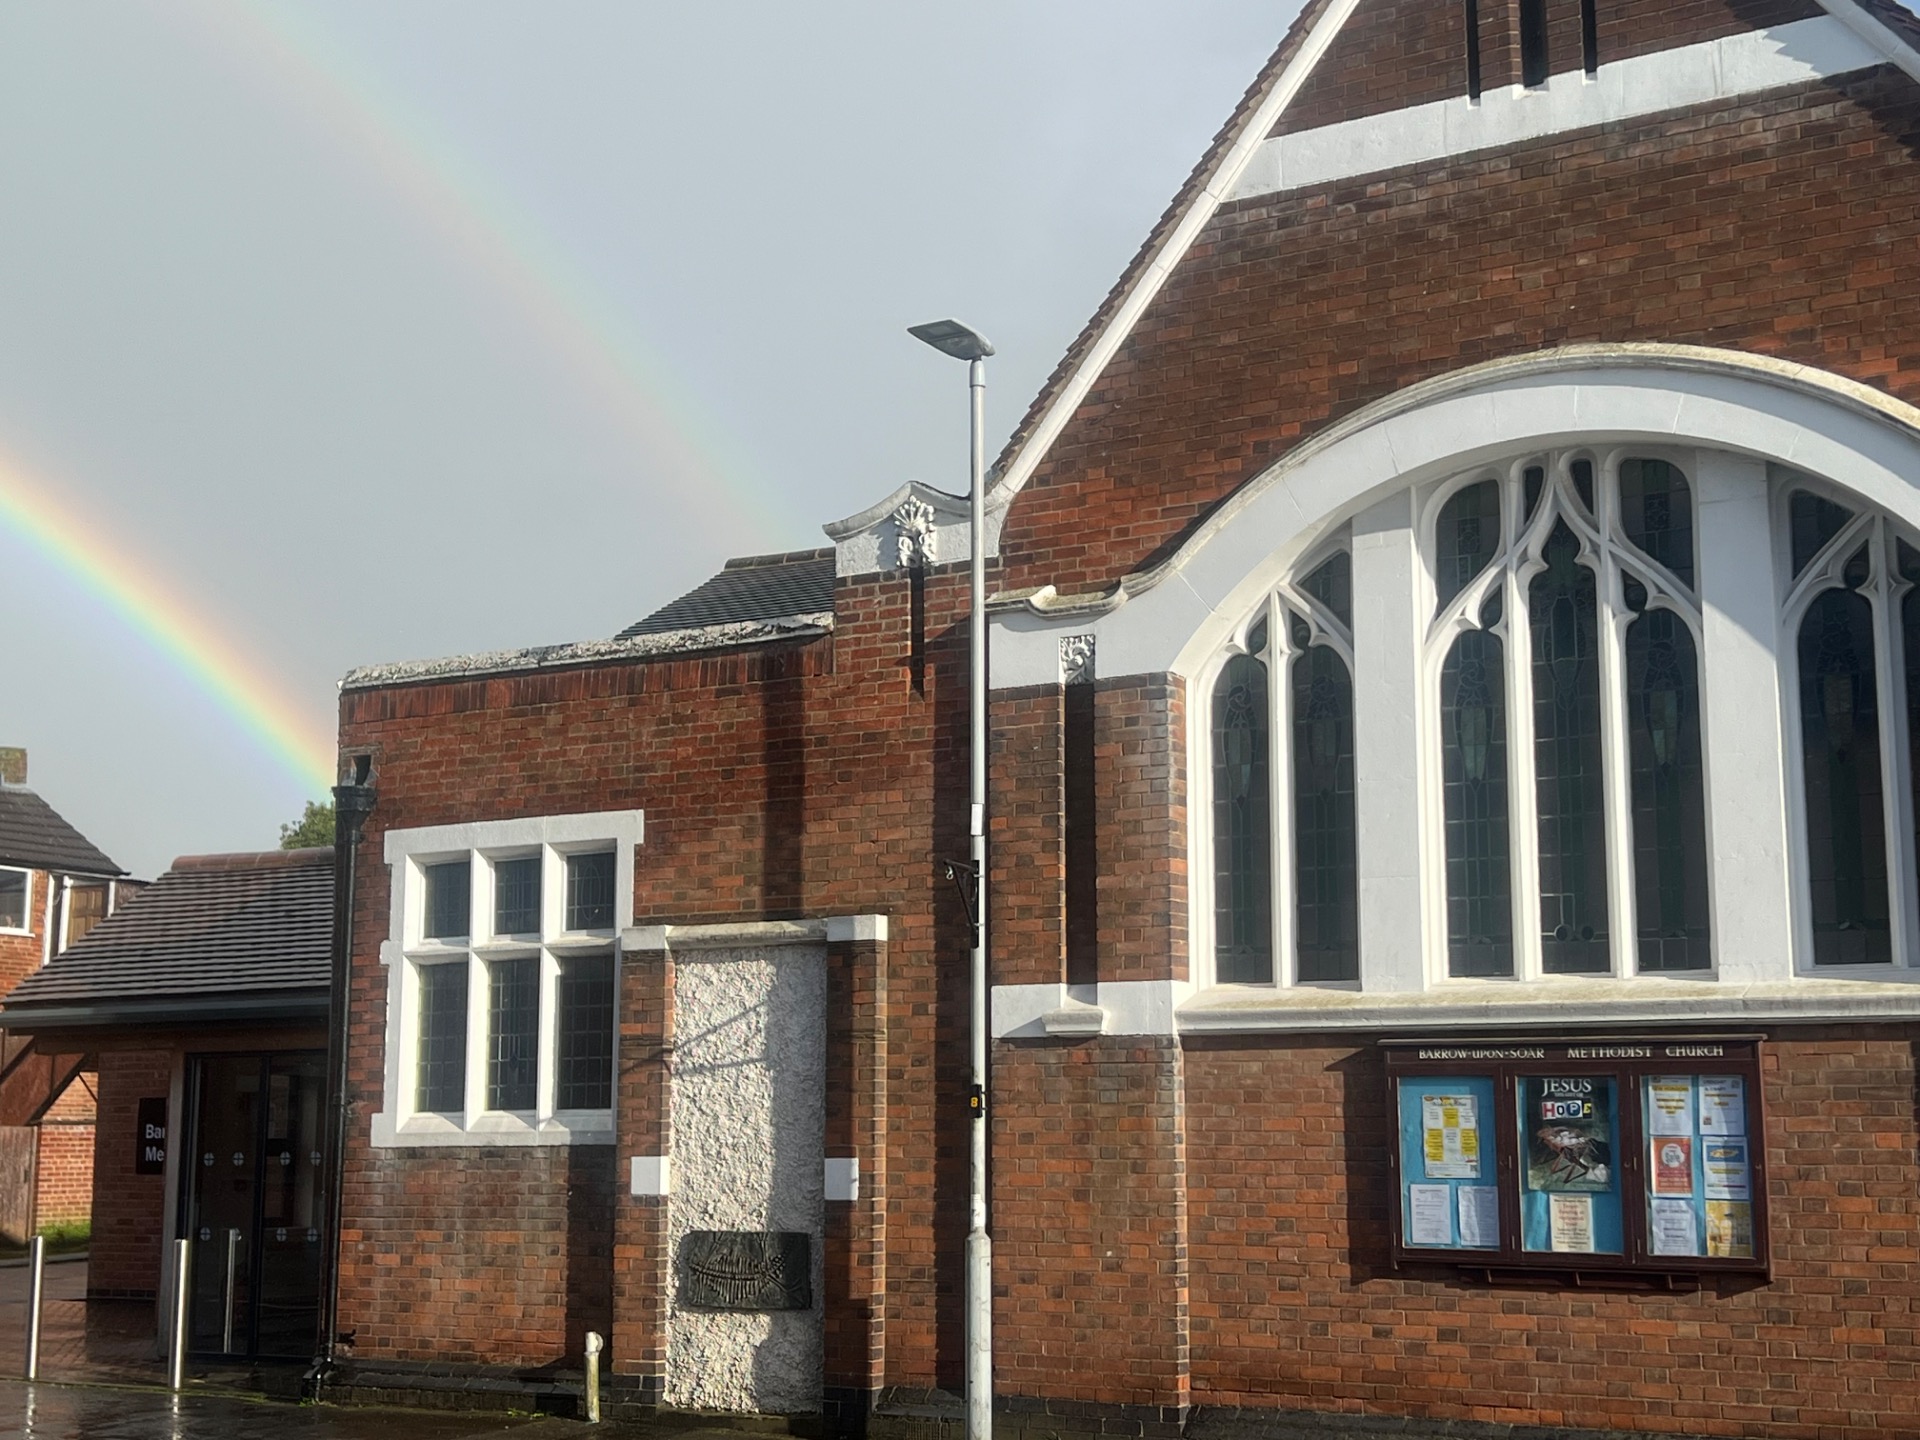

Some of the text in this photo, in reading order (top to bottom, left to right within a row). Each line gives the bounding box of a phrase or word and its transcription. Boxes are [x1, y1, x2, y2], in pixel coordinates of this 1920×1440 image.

[1567, 1046, 1653, 1059] METHODIST
[1665, 1045, 1724, 1057] CHURCH
[1541, 1078, 1592, 1097] JESUS
